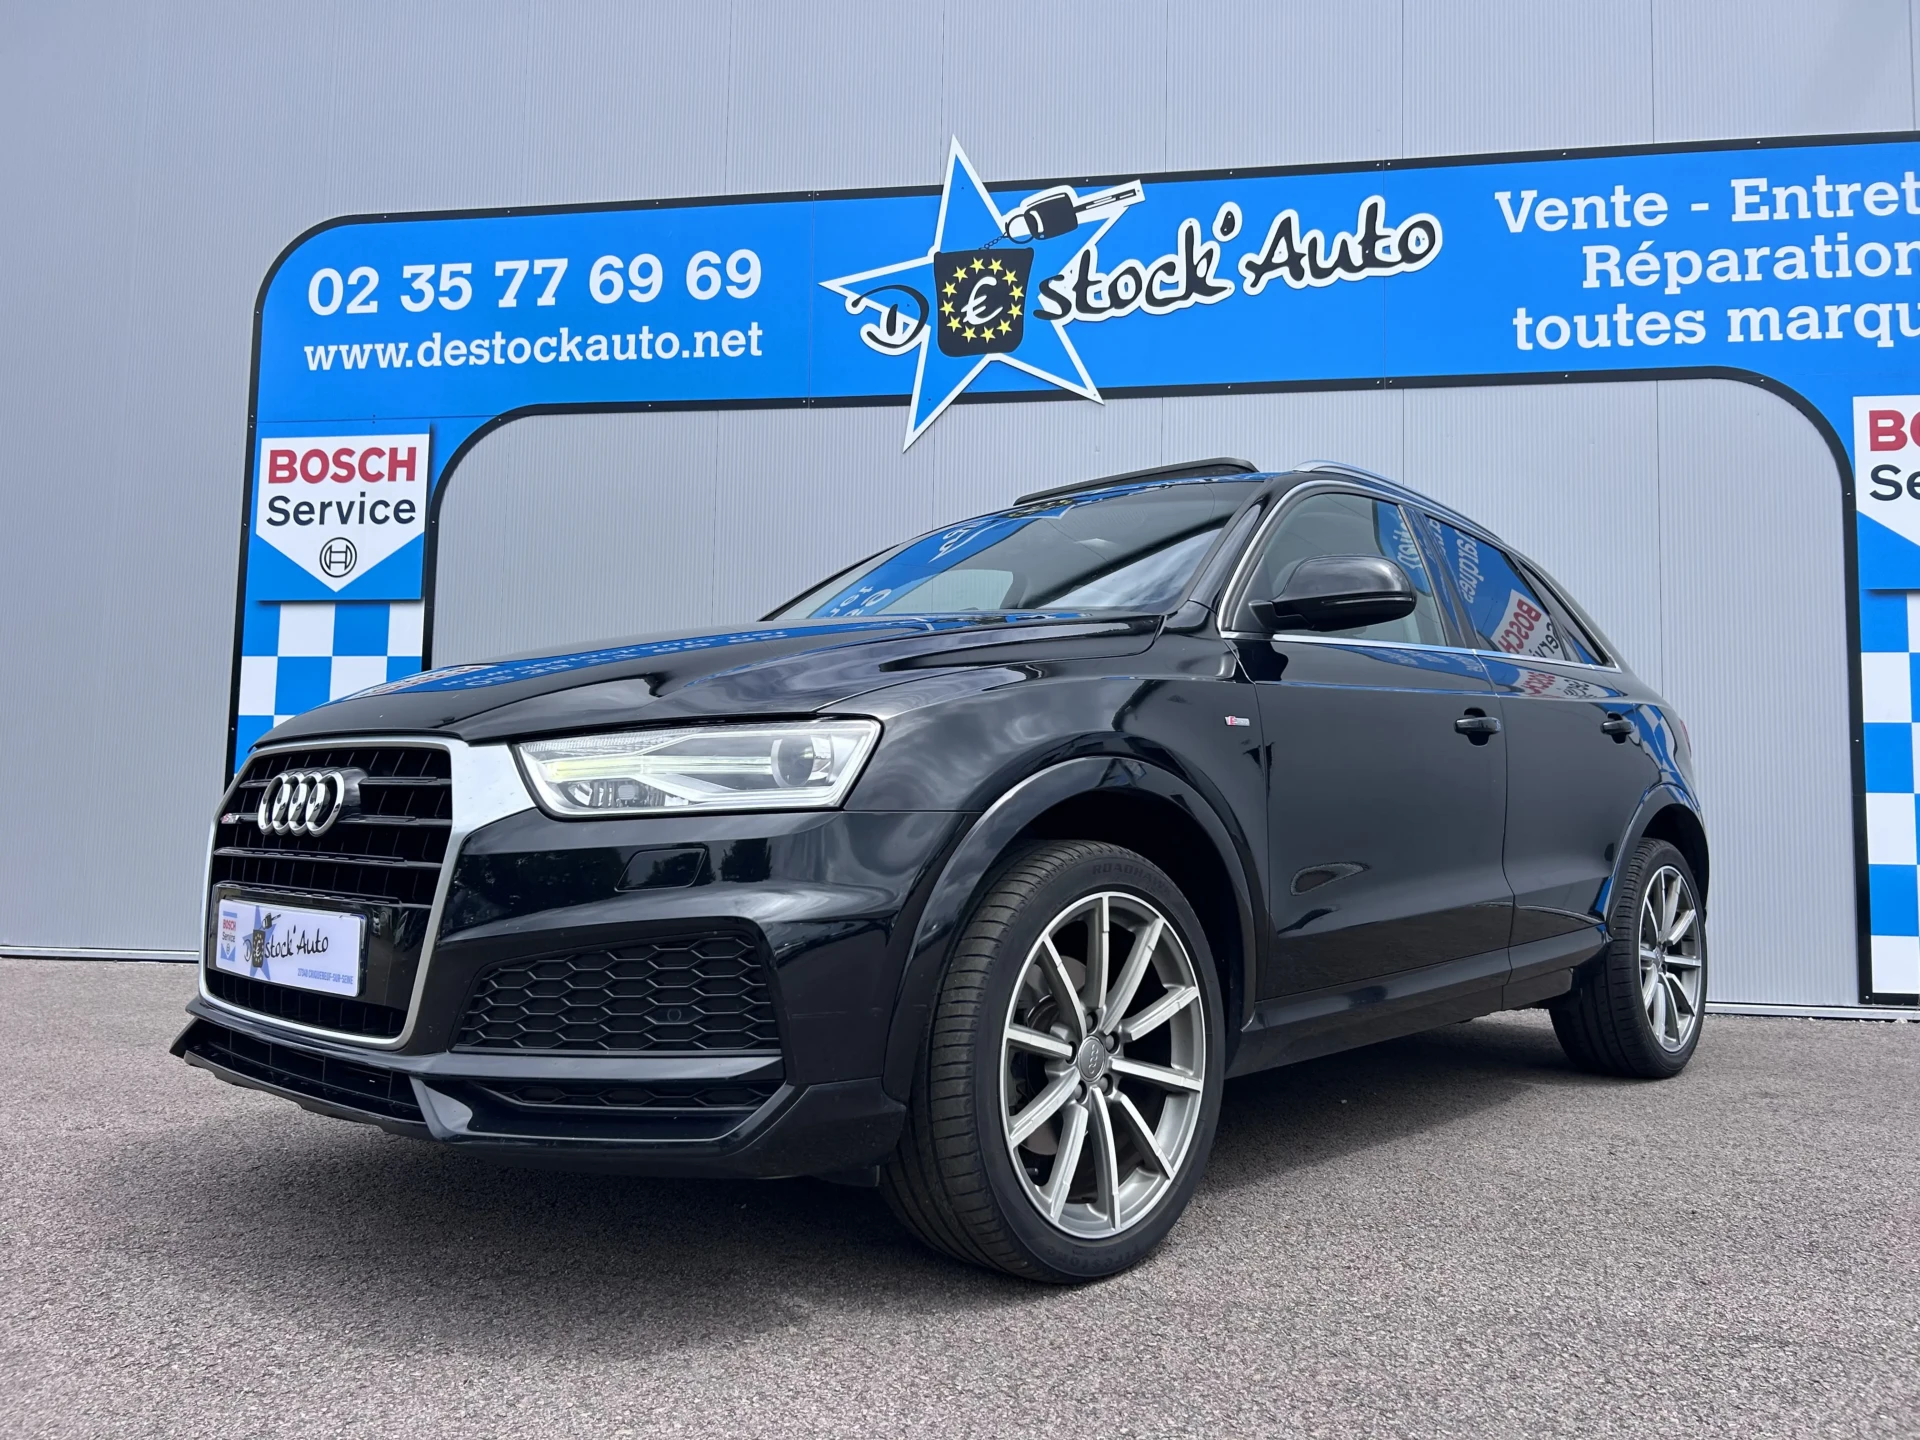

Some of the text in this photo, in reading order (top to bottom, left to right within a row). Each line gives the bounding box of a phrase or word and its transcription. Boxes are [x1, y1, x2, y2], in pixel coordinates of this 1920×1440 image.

[1494, 184, 1669, 233] Vente
[1730, 171, 1920, 222] Entret
[308, 248, 762, 316] 02 35 77 69 69
[1581, 231, 1920, 295] Réparation
[304, 321, 763, 371] www.destockauto.net
[1512, 302, 1920, 351] toutes marqu
[268, 446, 417, 484] BOSCH
[266, 491, 416, 526] Service
[222, 931, 236, 943] Service
[223, 919, 237, 932] BOSCH
